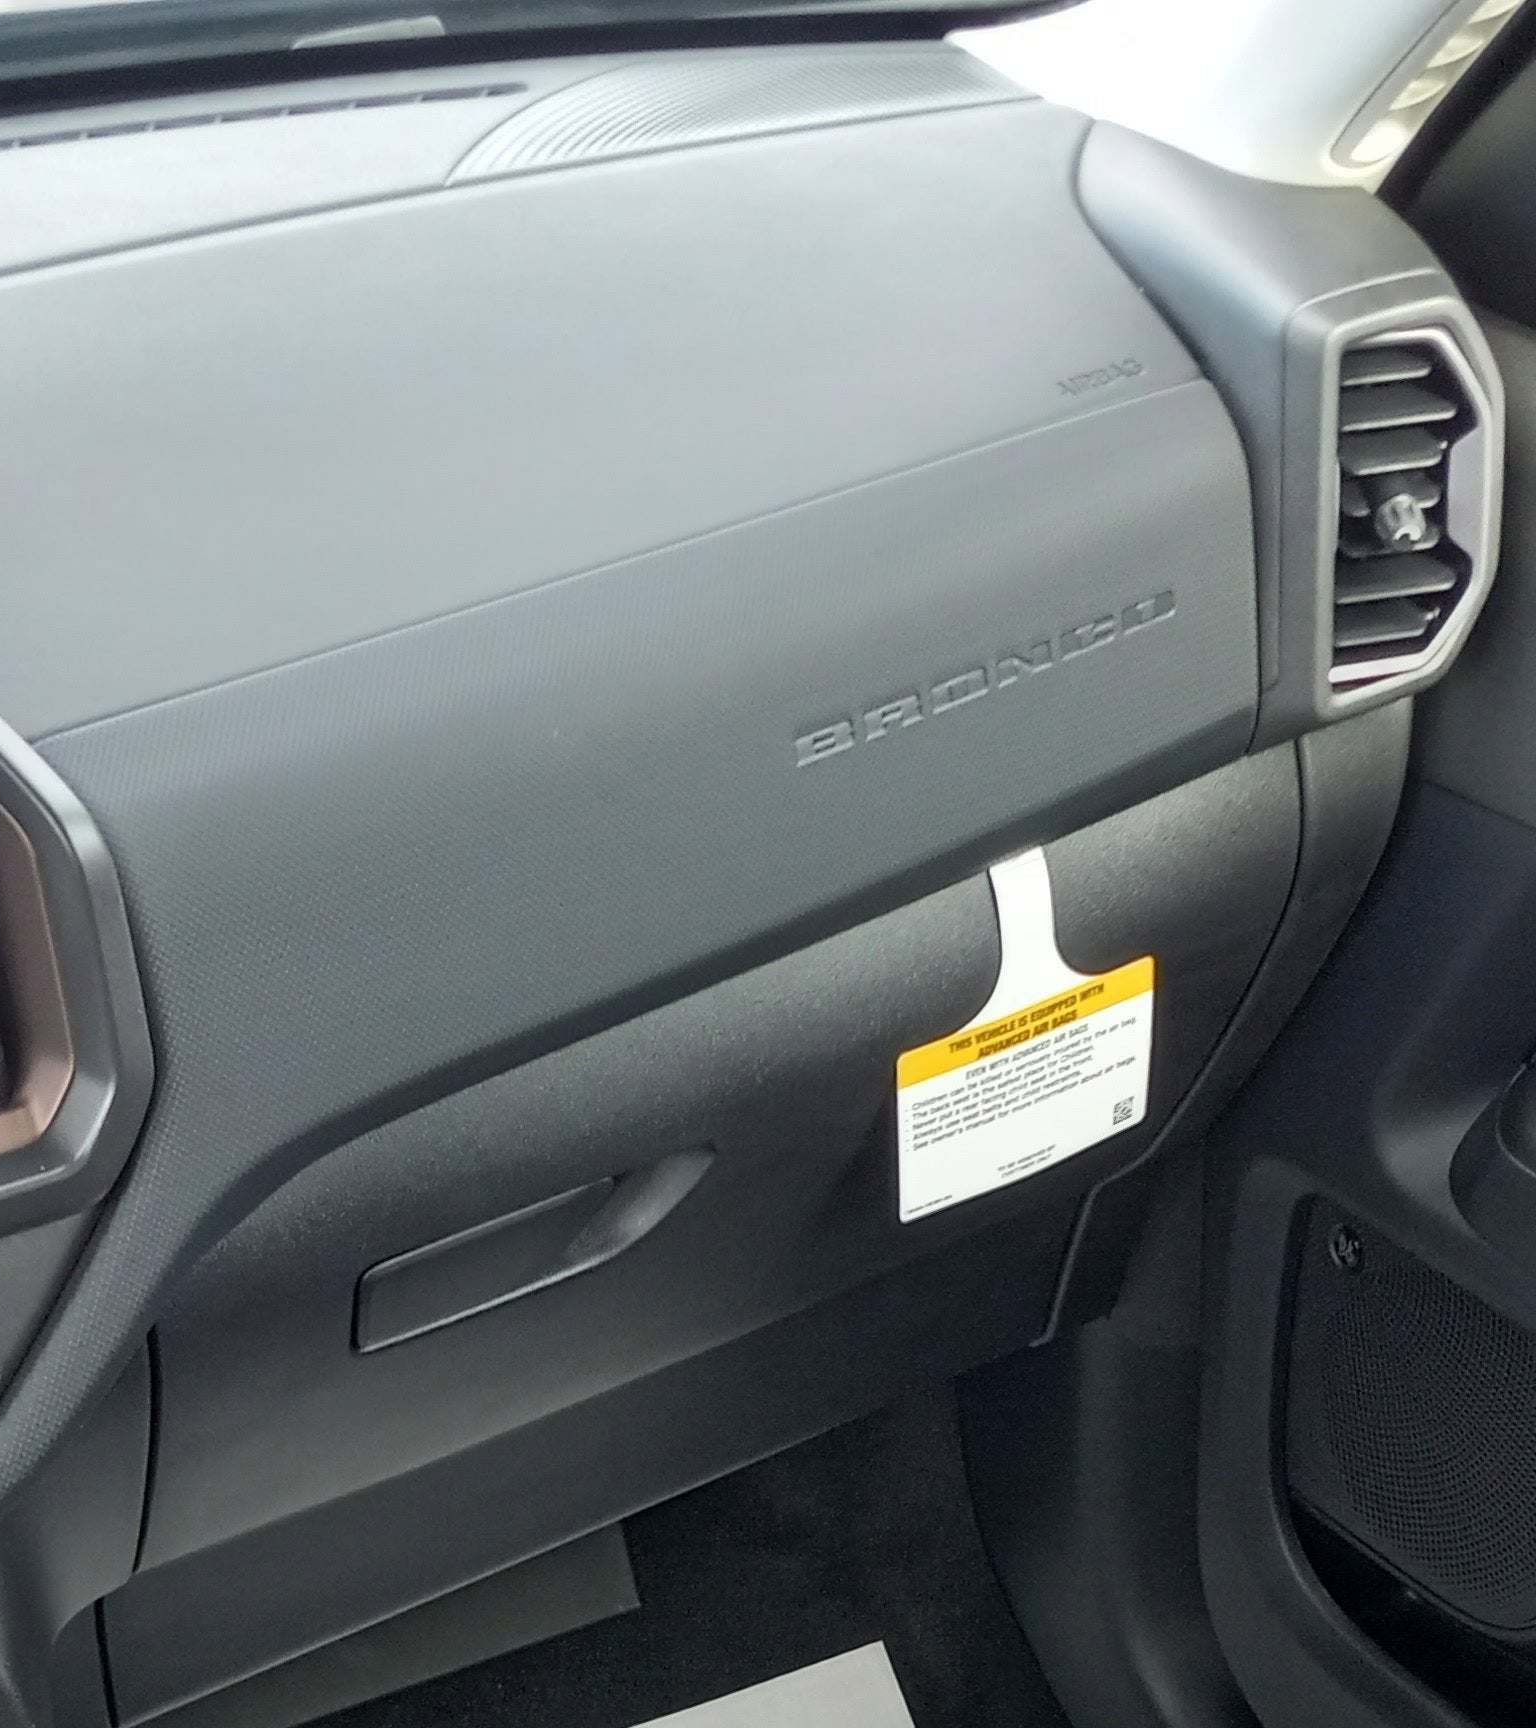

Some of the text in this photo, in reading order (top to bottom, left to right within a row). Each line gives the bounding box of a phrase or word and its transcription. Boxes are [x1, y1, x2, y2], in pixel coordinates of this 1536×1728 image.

[796, 590, 1177, 767] BRONCO
[949, 1036, 971, 1052] THIS
[975, 1020, 1015, 1043] VEHICLE
[1030, 995, 1076, 1021] EQUIPPED
[1079, 983, 1103, 1001] WITH
[978, 1009, 1076, 1058] ADVANCED AIR BAGS
